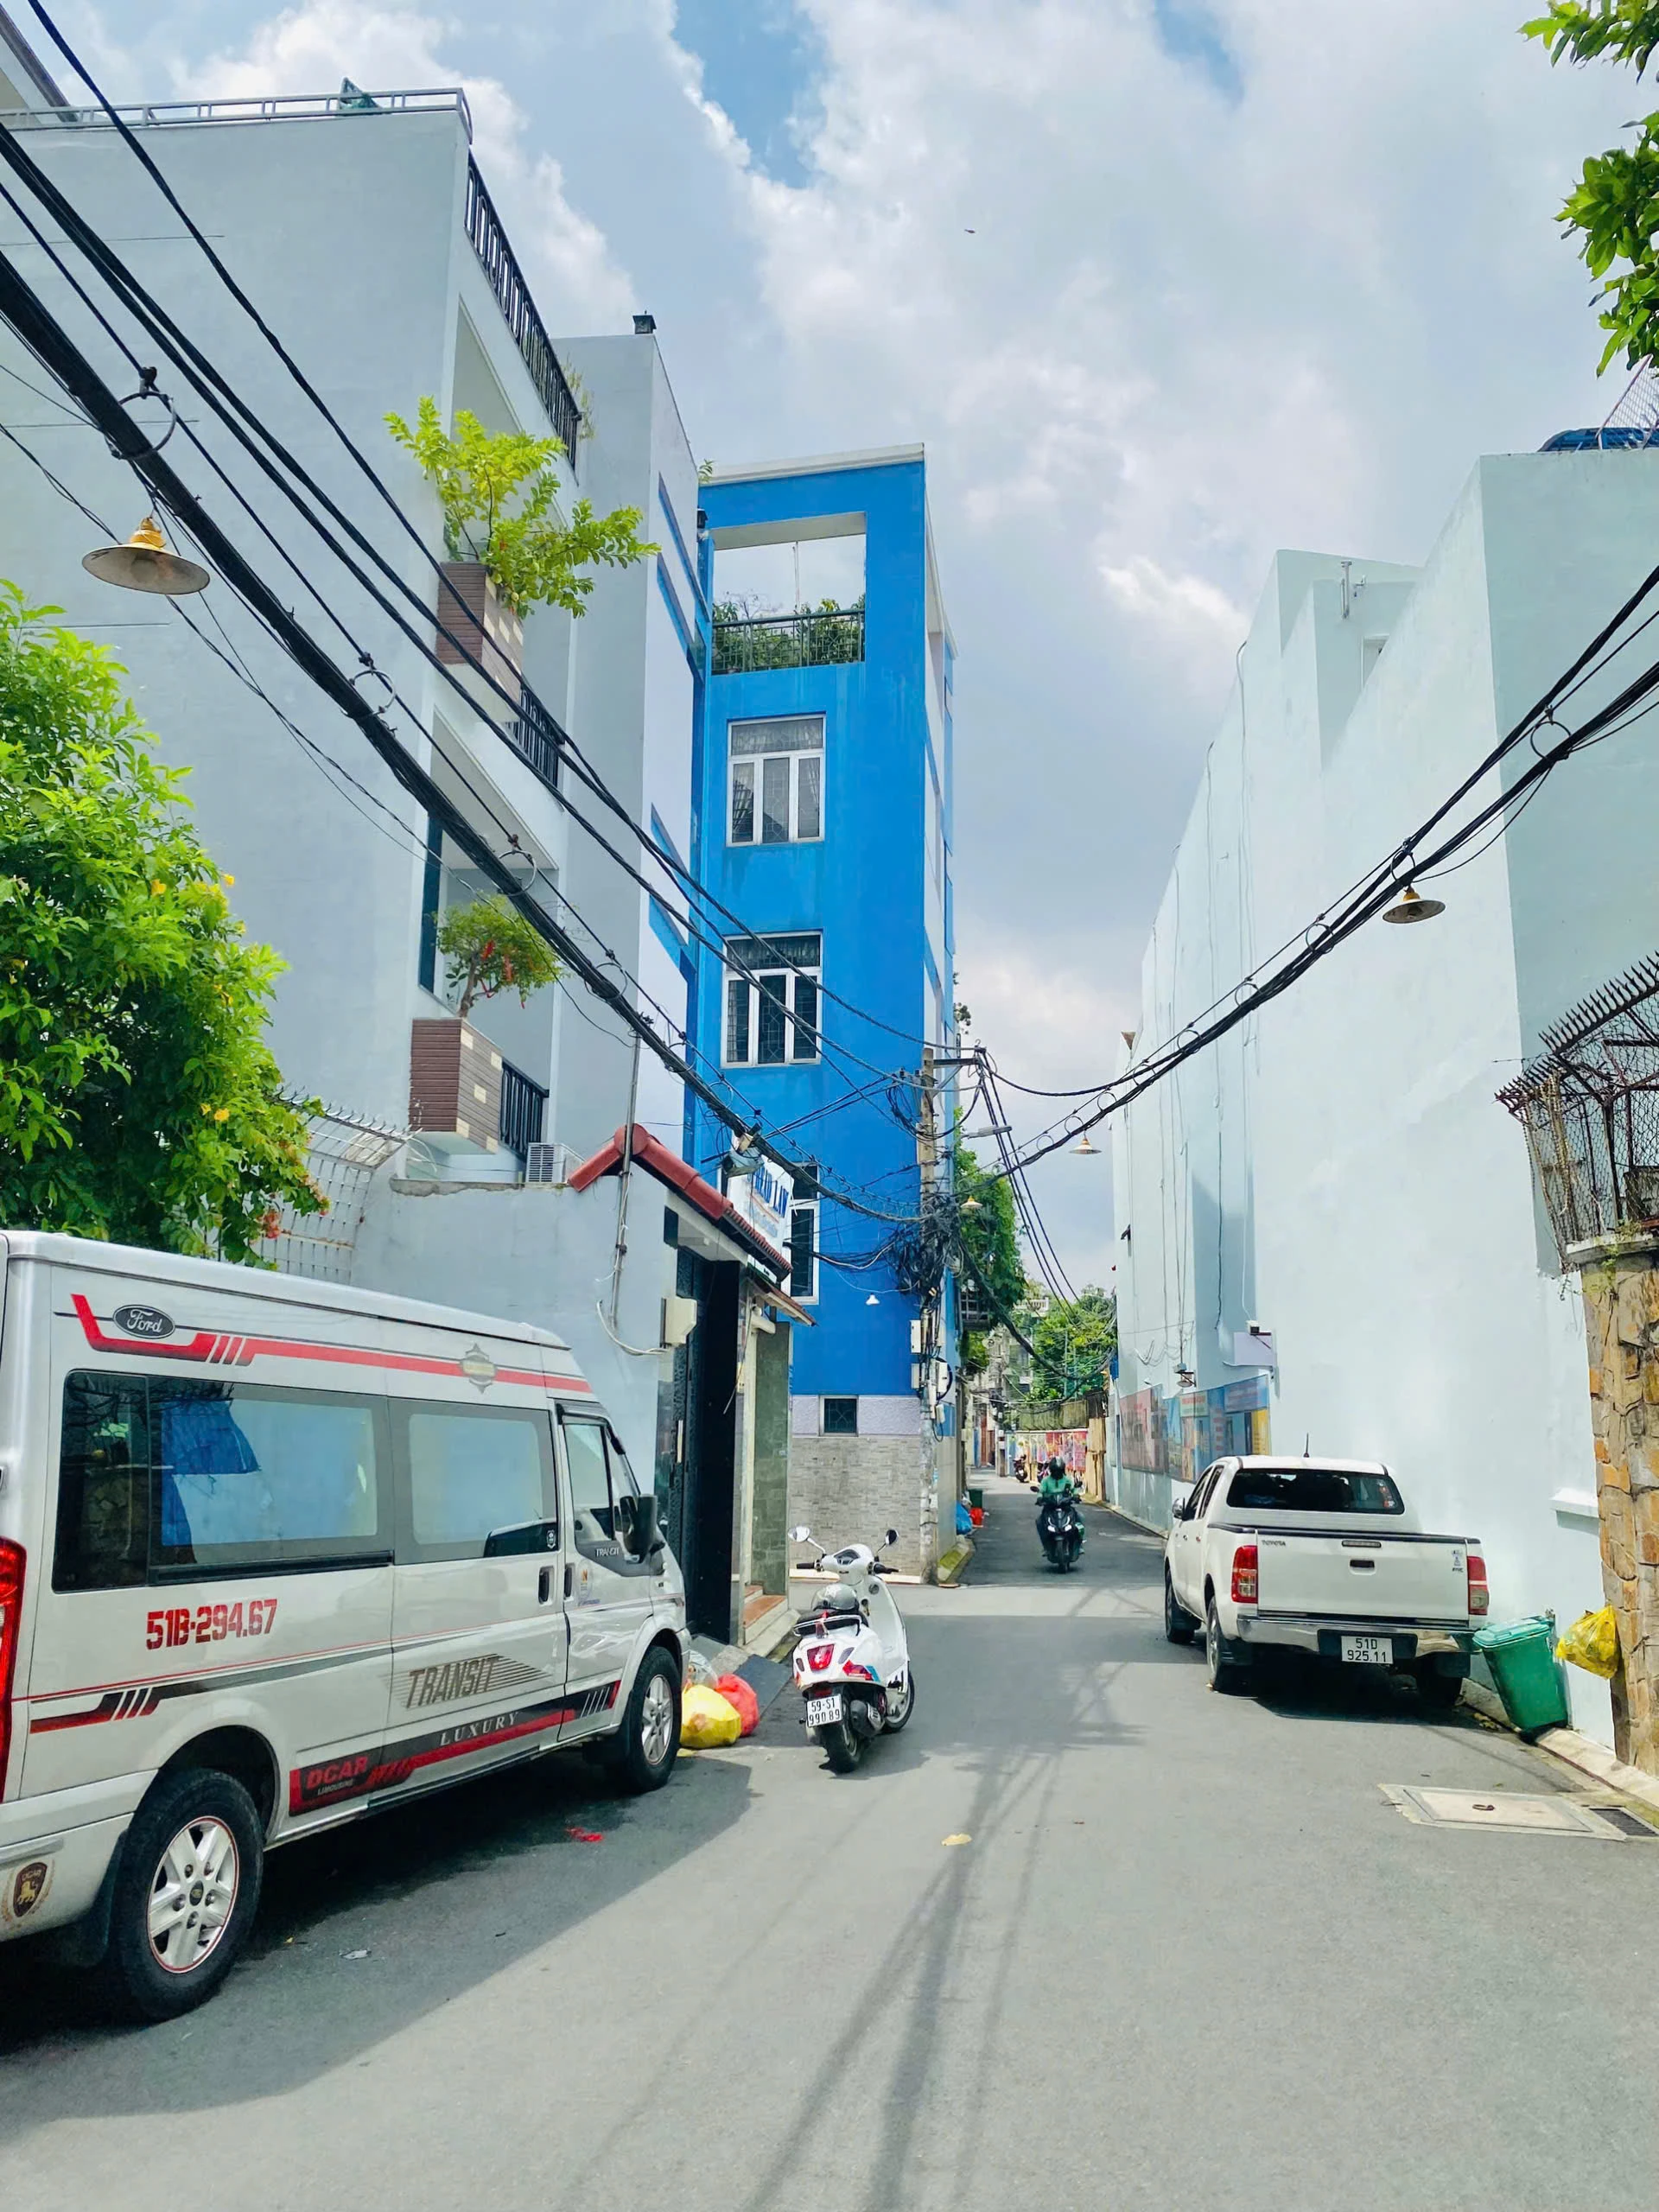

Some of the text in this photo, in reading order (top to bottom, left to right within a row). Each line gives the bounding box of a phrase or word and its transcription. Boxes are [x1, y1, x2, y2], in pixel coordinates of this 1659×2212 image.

[126, 1308, 163, 1333] Ford
[145, 1598, 278, 1650] 51B-294.67
[1346, 1649, 1387, 1663] 925.11
[1355, 1637, 1378, 1649] 51D
[406, 1656, 501, 1709] TRANSIT
[440, 1712, 519, 1746] LUXURY
